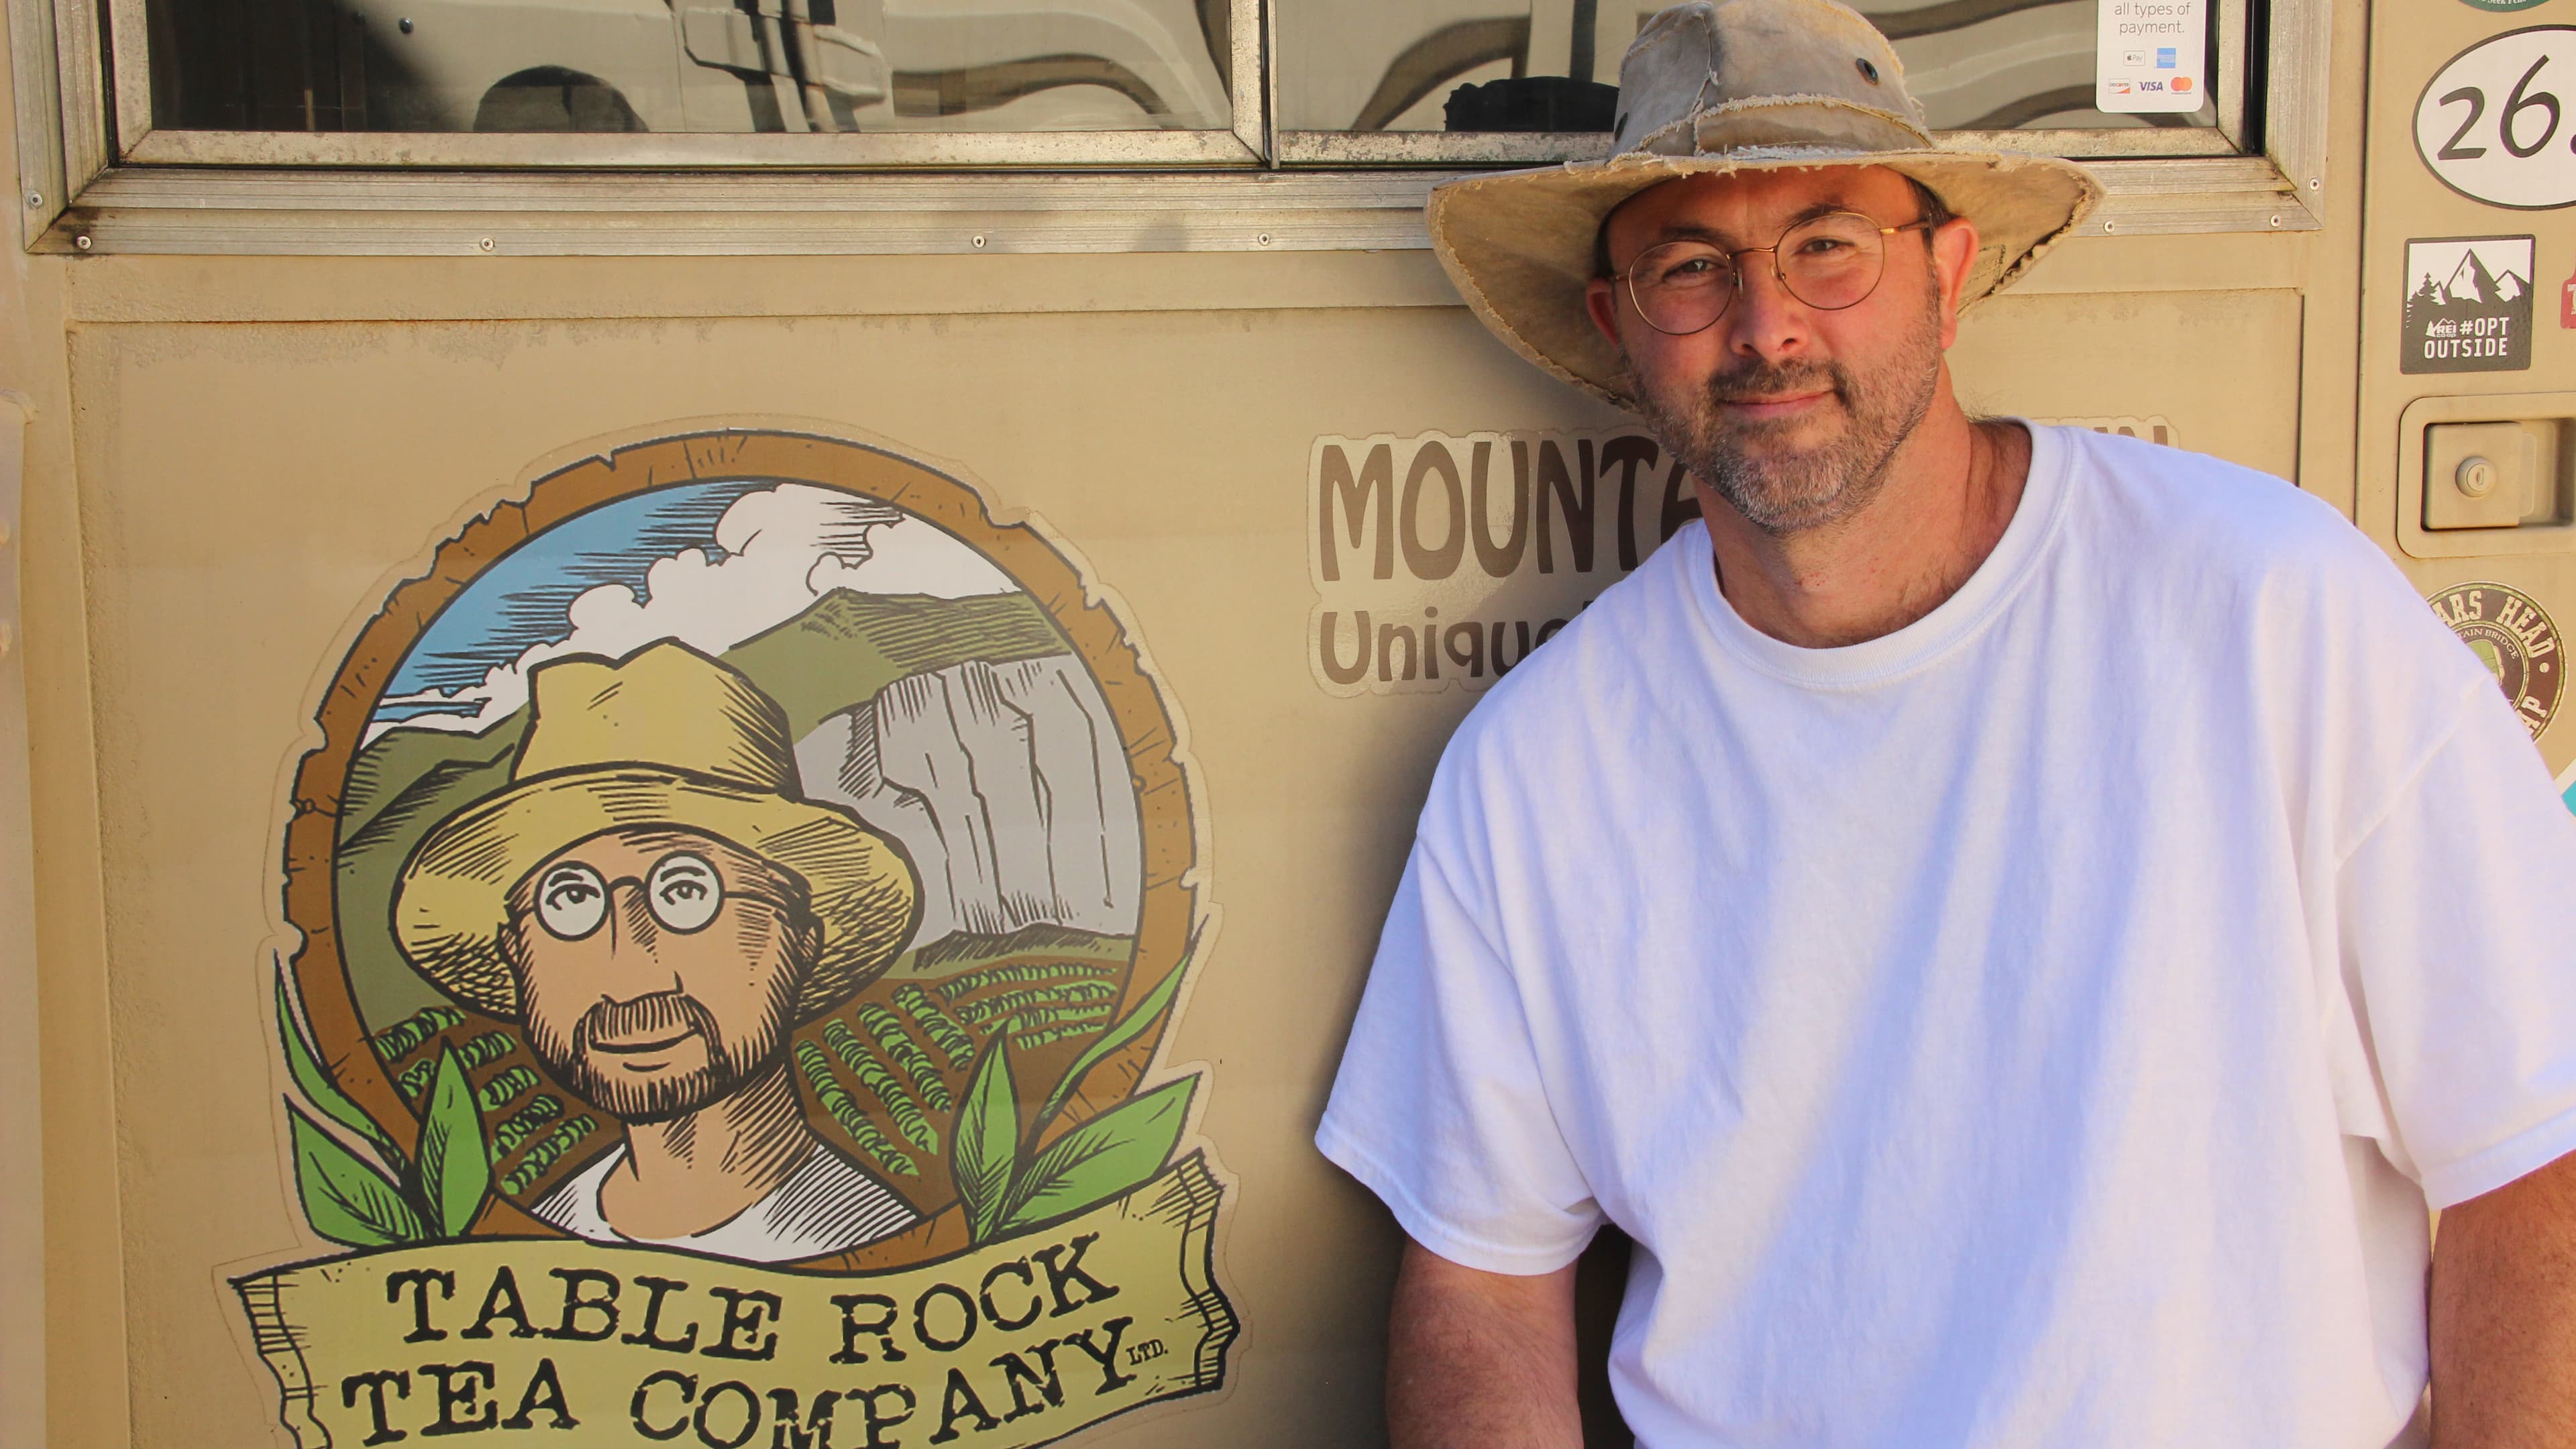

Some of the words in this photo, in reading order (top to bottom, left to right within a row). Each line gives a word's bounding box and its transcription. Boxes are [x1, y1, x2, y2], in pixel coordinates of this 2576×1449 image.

[2114, 3, 2129, 15] all
[2135, 4, 2172, 17] types
[2178, 3, 2191, 15] of
[2120, 20, 2184, 36] payment.
[2133, 54, 2143, 62] Pay
[2139, 82, 2163, 91] VISA
[2436, 325, 2457, 333] REI
[2459, 317, 2510, 336] #OPT
[2424, 337, 2508, 358] OUTSIDE
[2496, 596, 2555, 658] HEAD
[2485, 629, 2518, 659] BRIDGE
[386, 1265, 782, 1360] TABLE
[829, 1232, 1120, 1364] ROCK
[341, 1358, 580, 1446] TEA
[630, 1316, 1136, 1449] COMPANY
[1128, 1338, 1169, 1366] LTD.
